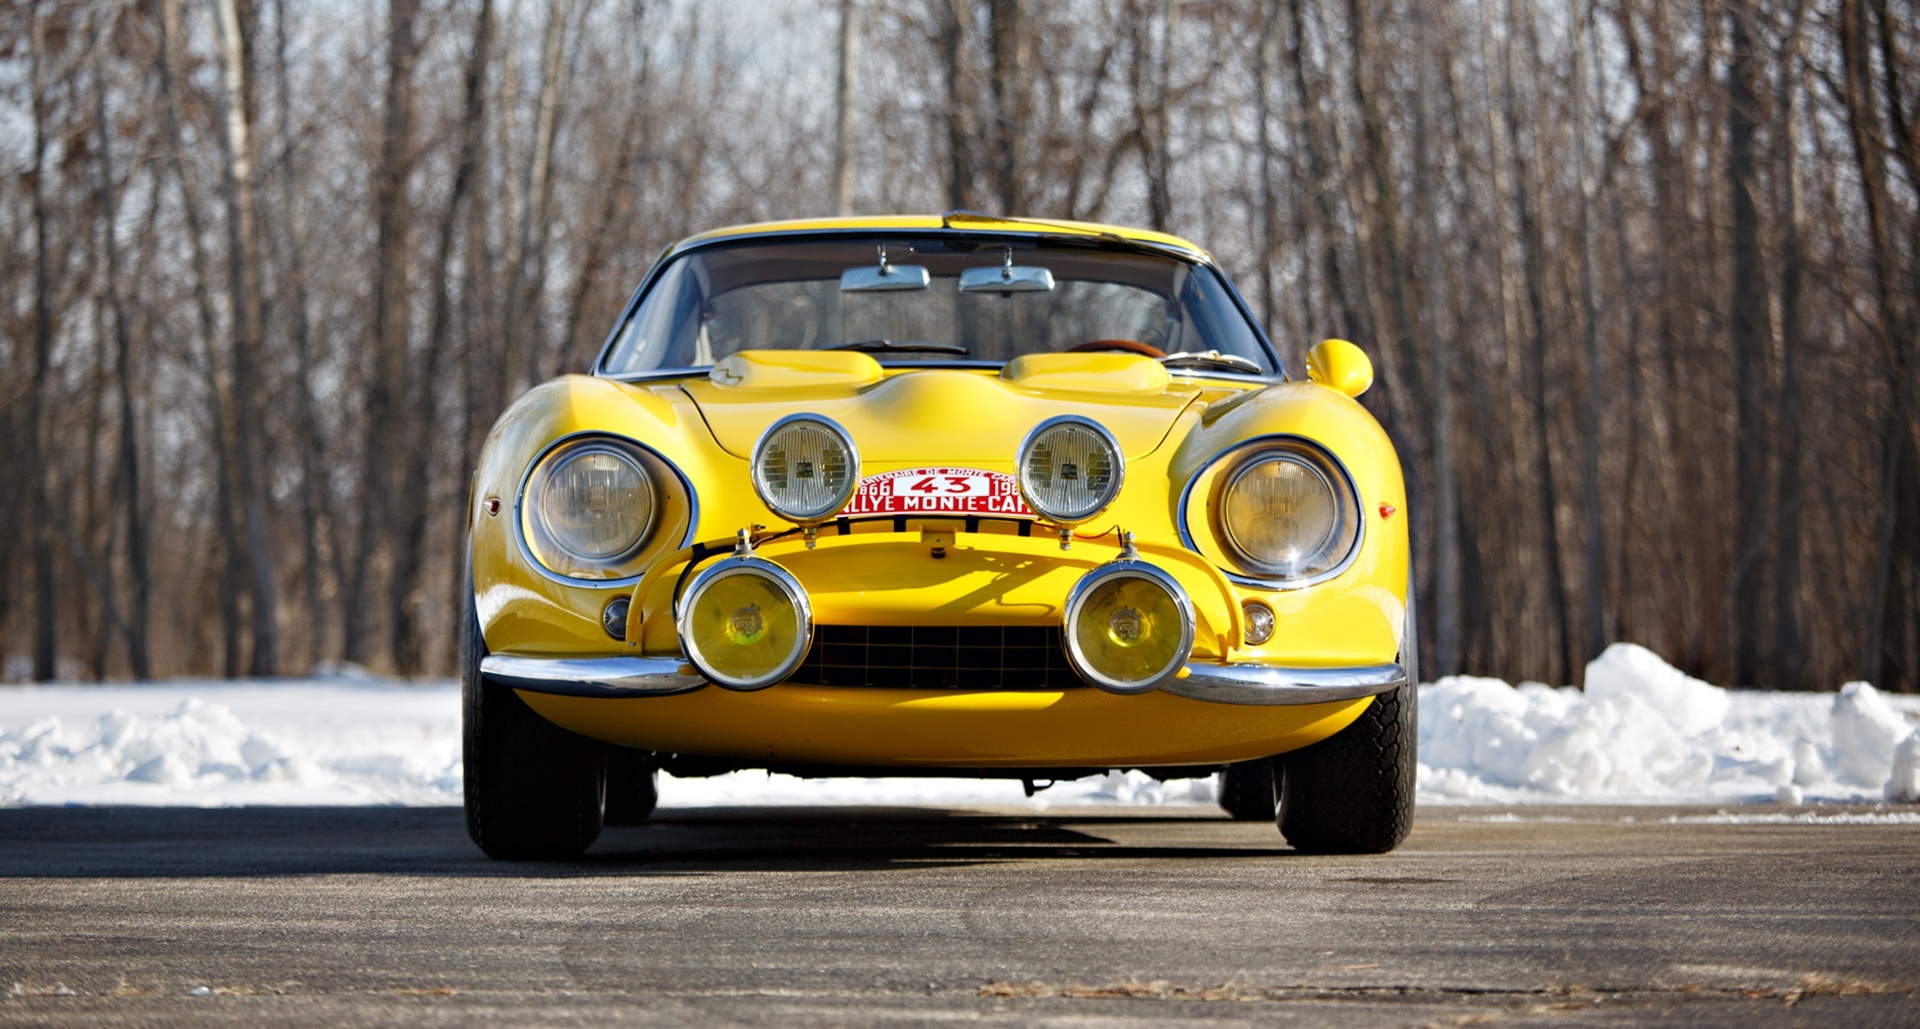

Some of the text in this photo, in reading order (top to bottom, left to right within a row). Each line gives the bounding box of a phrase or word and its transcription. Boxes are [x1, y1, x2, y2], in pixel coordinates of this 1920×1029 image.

[859, 469, 918, 486] ENTENAIRE
[947, 468, 985, 477] MONTE
[910, 476, 972, 494] 43
[857, 480, 890, 497] 866
[993, 480, 1018, 496] 196
[904, 496, 1032, 513] MONTE-CAR
